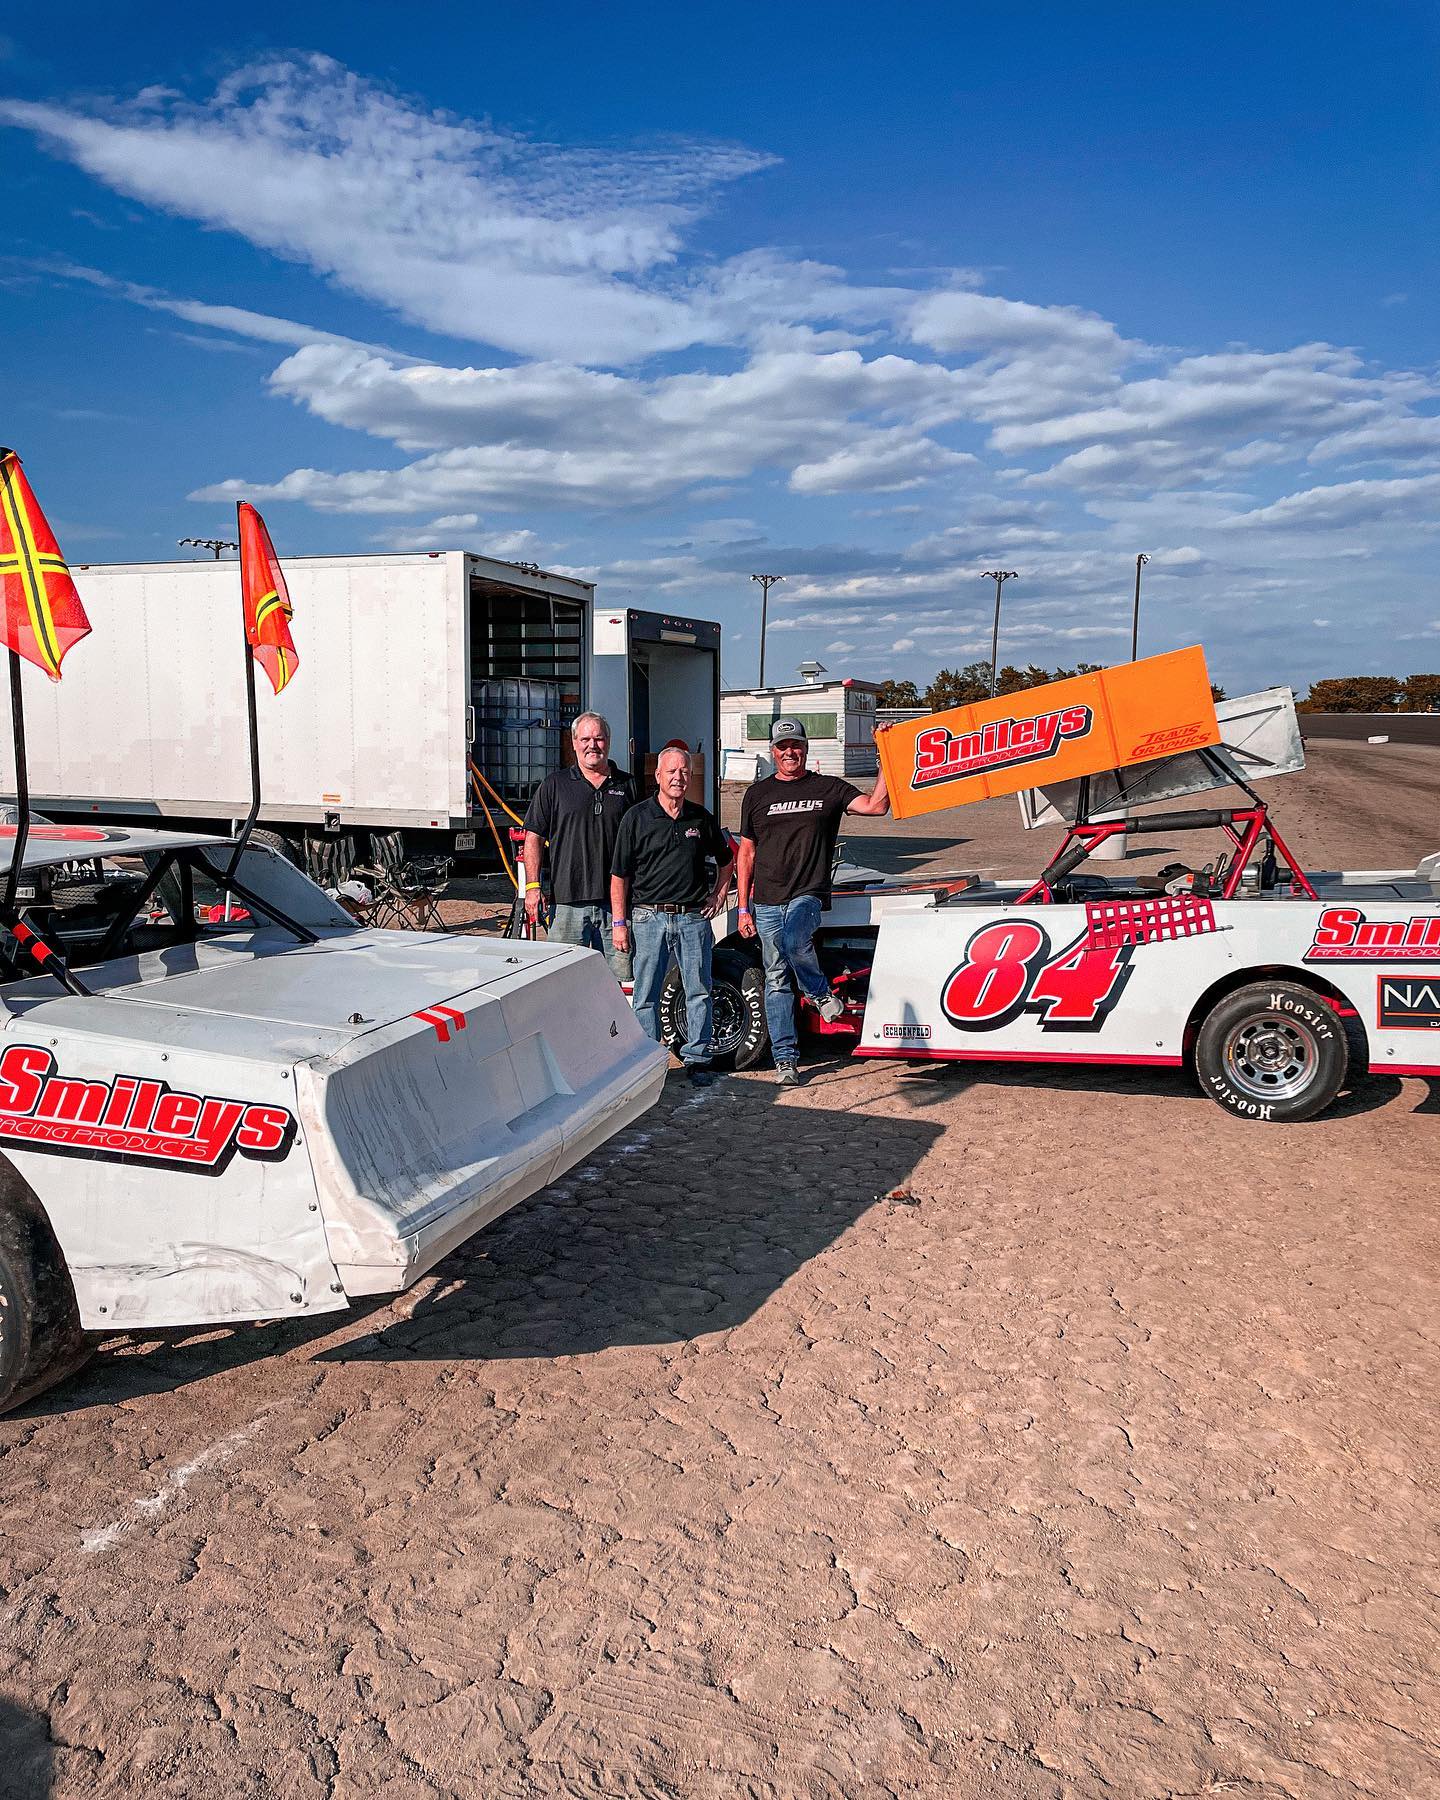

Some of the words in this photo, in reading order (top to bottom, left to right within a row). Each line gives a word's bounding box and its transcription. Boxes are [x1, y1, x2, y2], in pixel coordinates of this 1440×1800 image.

[915, 704, 1089, 769] Smileys
[921, 762, 969, 780] RACING
[972, 743, 1045, 767] PRODUCTS
[1314, 908, 1440, 946] Smil
[941, 919, 1130, 1025] 84
[1314, 948, 1380, 957] RACING
[660, 983, 677, 1045] Hoosier
[741, 986, 764, 1051] Hoosier
[1266, 992, 1334, 1041] Hoosier
[1383, 983, 1440, 1009] NA
[885, 1026, 929, 1037] SCHOENFELD
[0, 1046, 292, 1167] Smileys
[1209, 1074, 1276, 1121] Hoosier
[71, 1128, 208, 1158] PRODUCTS
